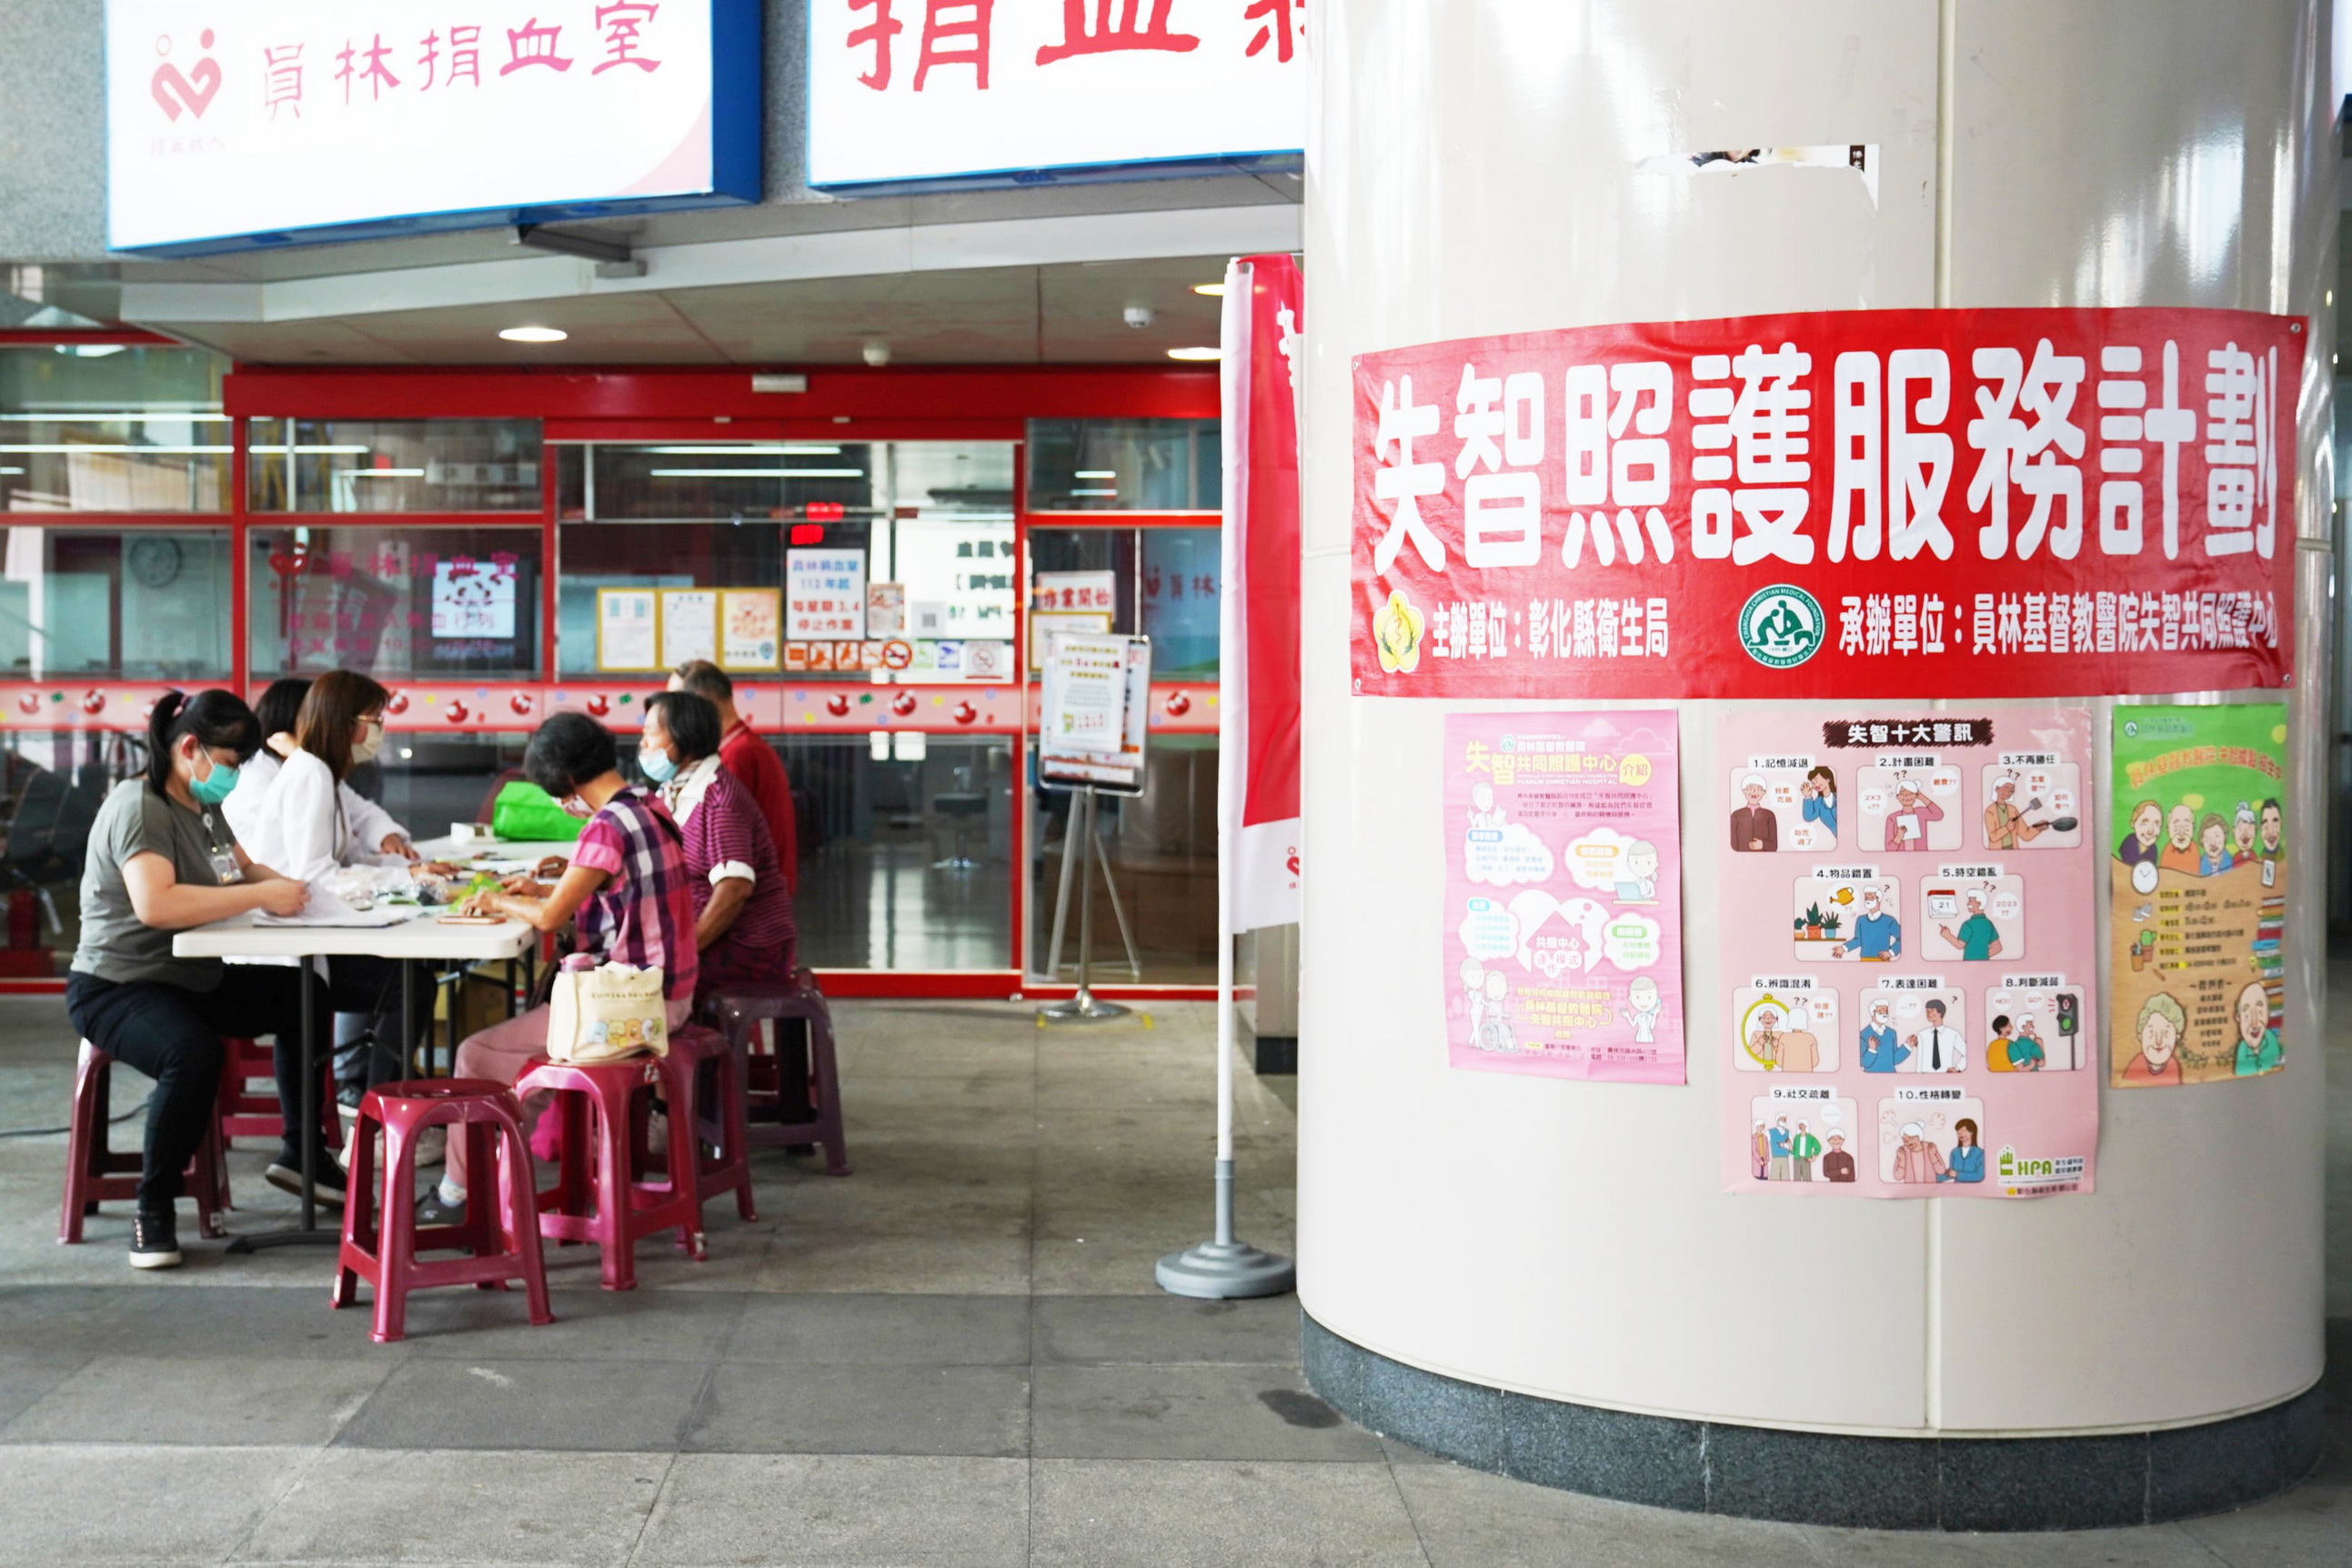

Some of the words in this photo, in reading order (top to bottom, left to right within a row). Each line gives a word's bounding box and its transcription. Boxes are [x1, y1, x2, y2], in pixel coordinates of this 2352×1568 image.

[847, 0, 1304, 92] 捐血
[264, 0, 662, 120] 員林捐血室
[1374, 337, 2278, 576] 失智照護服務計劃
[1744, 604, 1754, 638] CHANGHUA
[1752, 588, 1780, 607] CHRISTIAN
[1780, 588, 1806, 601] MEDICAL
[1847, 724, 1974, 744] 失智十大警訊
[1753, 758, 1809, 769] 1.記憶減退
[1816, 868, 1872, 879] 4.物品錯置
[1774, 1089, 1830, 1100] 9.社交疏離
[2017, 1160, 2052, 1175] HPA
